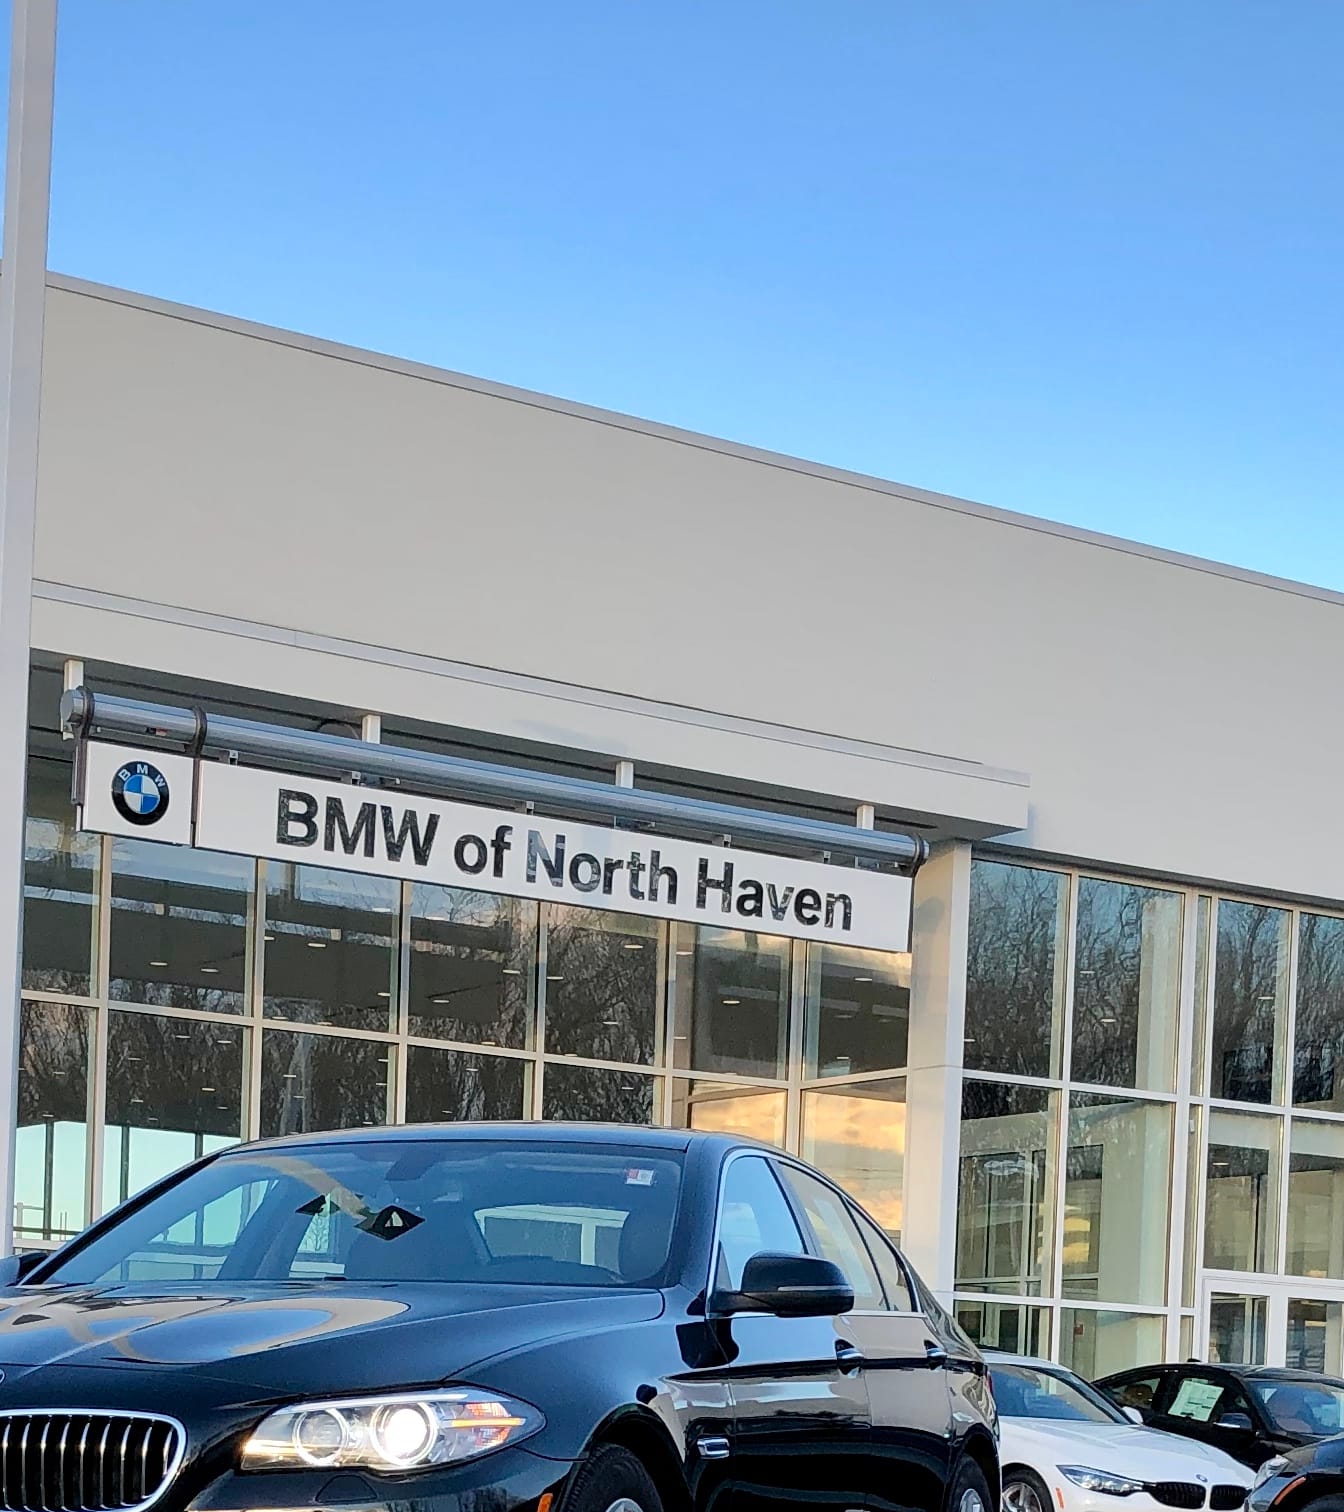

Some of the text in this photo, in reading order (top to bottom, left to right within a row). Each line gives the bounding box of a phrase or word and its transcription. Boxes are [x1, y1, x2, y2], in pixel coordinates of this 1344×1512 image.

[117, 763, 166, 788] BMW
[276, 787, 853, 932] BMW of North Haven
